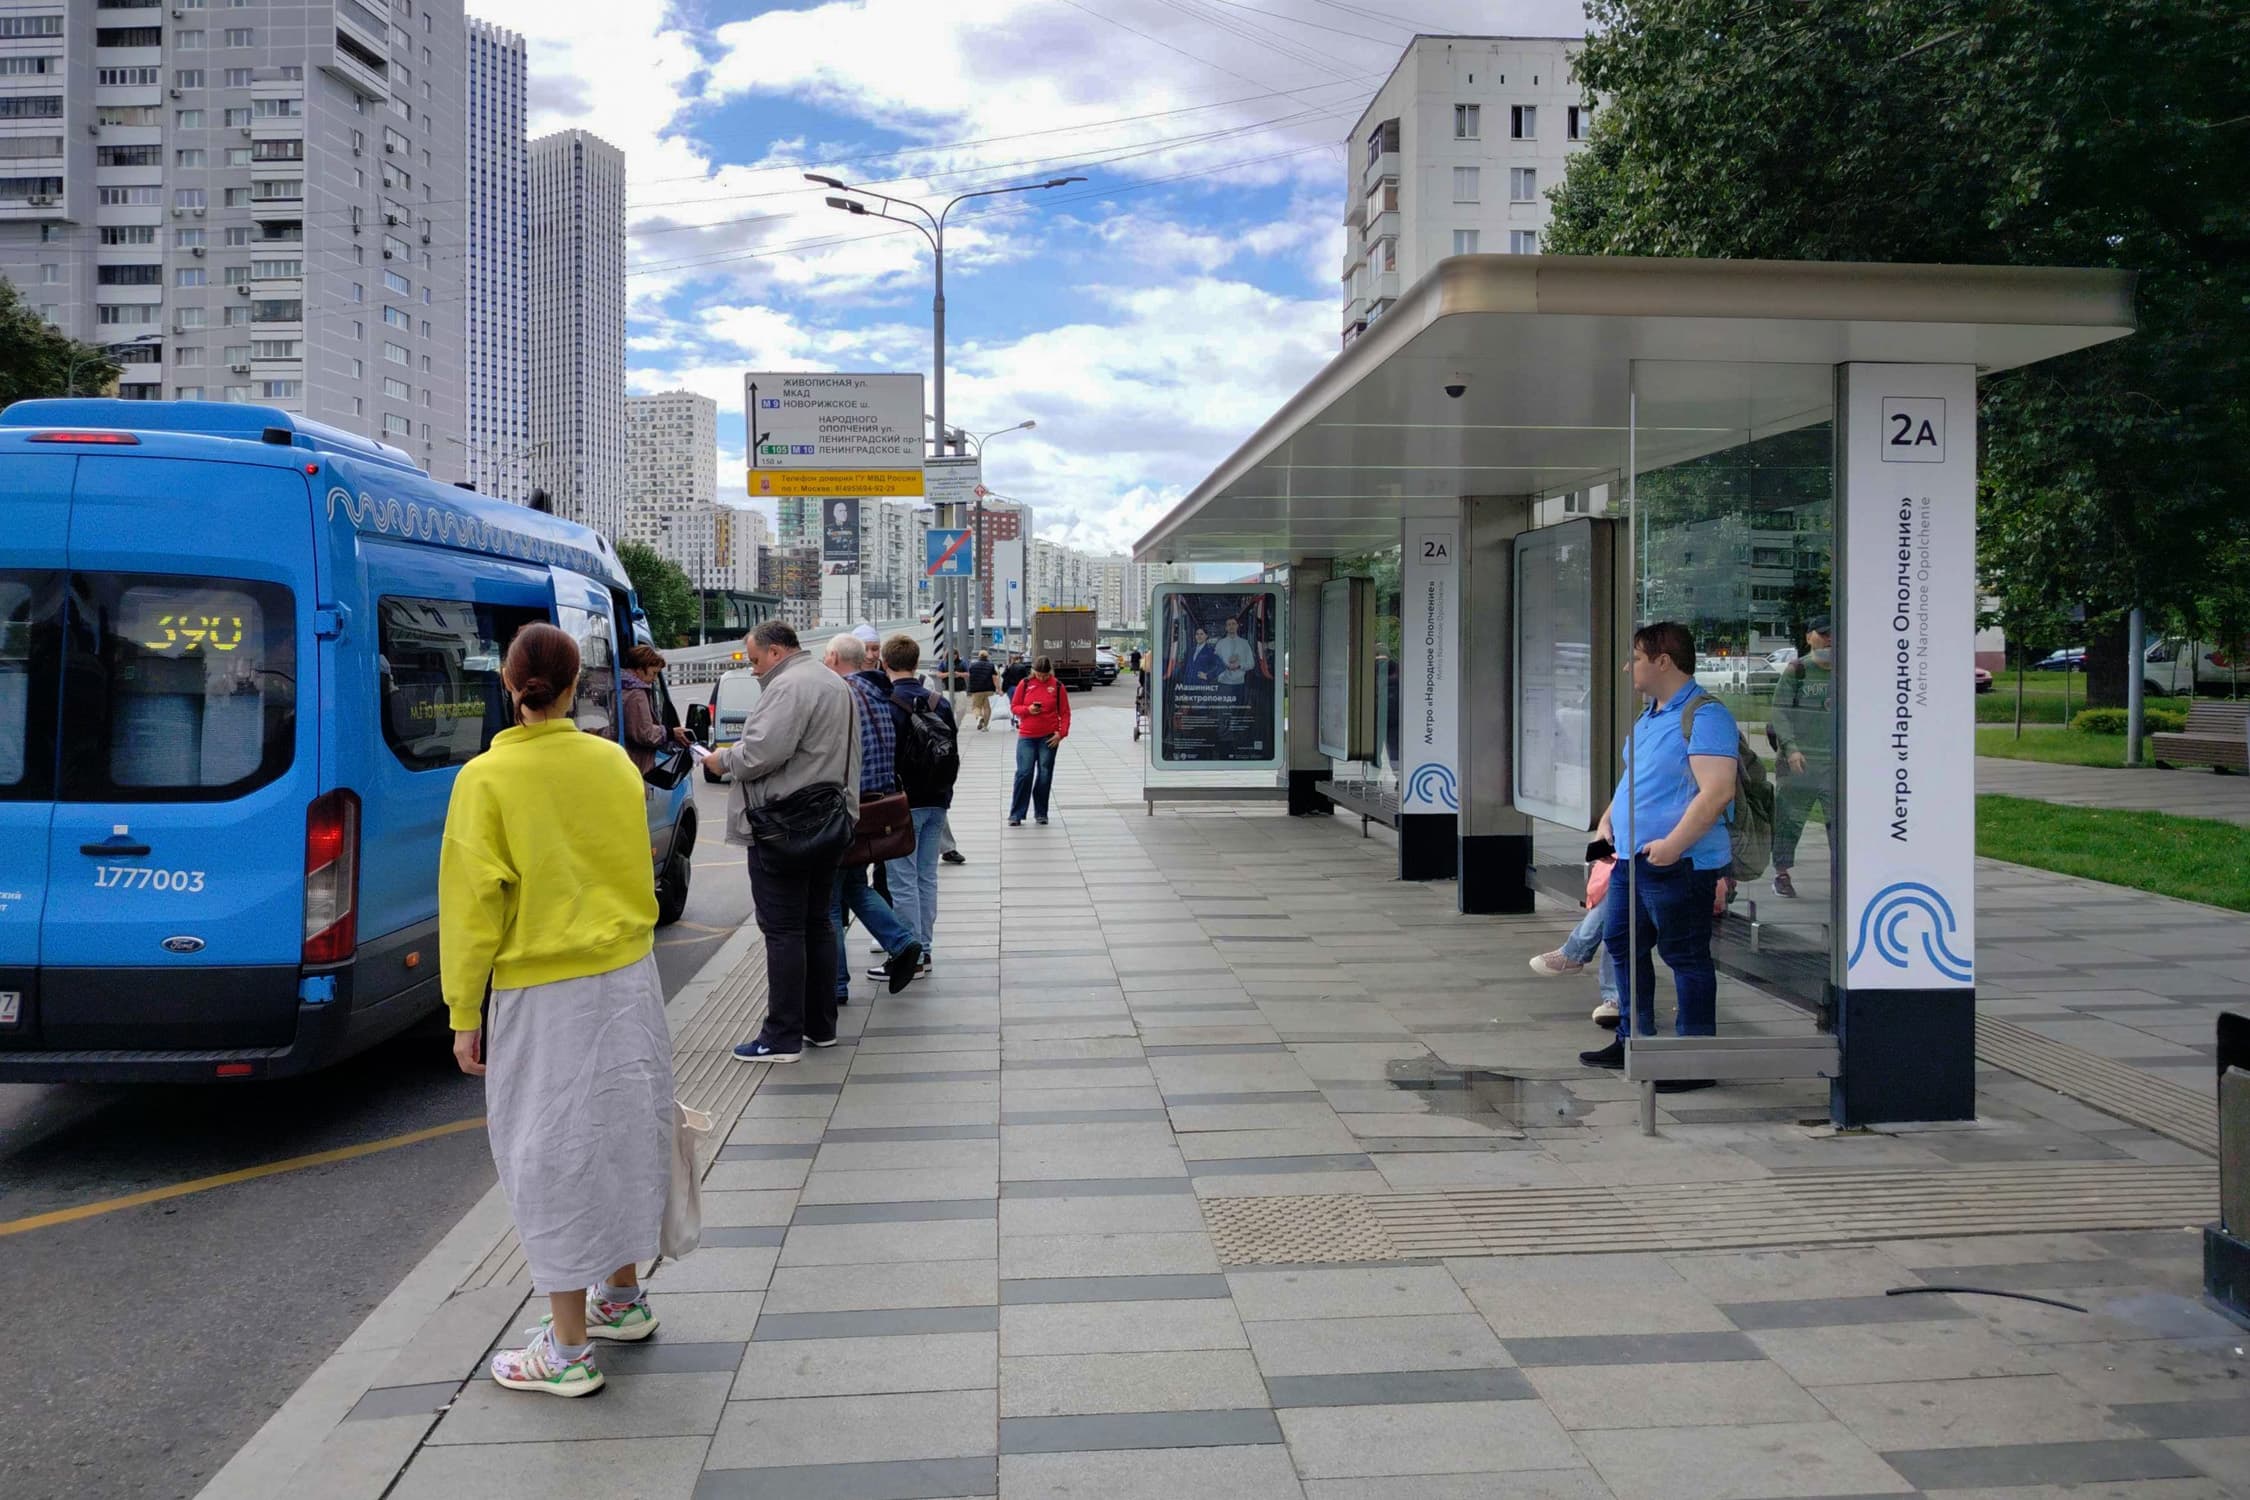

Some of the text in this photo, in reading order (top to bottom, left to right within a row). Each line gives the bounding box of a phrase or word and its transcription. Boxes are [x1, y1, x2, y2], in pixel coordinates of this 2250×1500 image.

[783, 378, 868, 389] ЖИВОПИСНАЯ ул.
[783, 389, 811, 398] МКАД
[783, 400, 857, 409] НОВОРИЖСКОЕ
[819, 415, 878, 424] НАРОДНОГО
[819, 424, 894, 434] ОПОЛЧЕНИЯ ул.
[818, 433, 900, 444] ЛЕНИНГРАДСКИЙ
[772, 445, 788, 454] 105
[819, 446, 901, 455] ЛЕНИНГРАДСКОЕ
[781, 474, 817, 483] Телефон
[819, 475, 853, 483] доверия
[867, 475, 886, 483] МВД
[1916, 496, 1931, 708] Metro Narodnoe Opolchenie
[145, 614, 243, 652] 390
[1424, 581, 1435, 745] Метро «Народное Ополчение»
[1890, 496, 1912, 843] Метро «Народное Ополчение»
[1174, 683, 1219, 692] Машинист
[1174, 695, 1237, 704] электропоезда
[94, 865, 206, 893] 1777003
